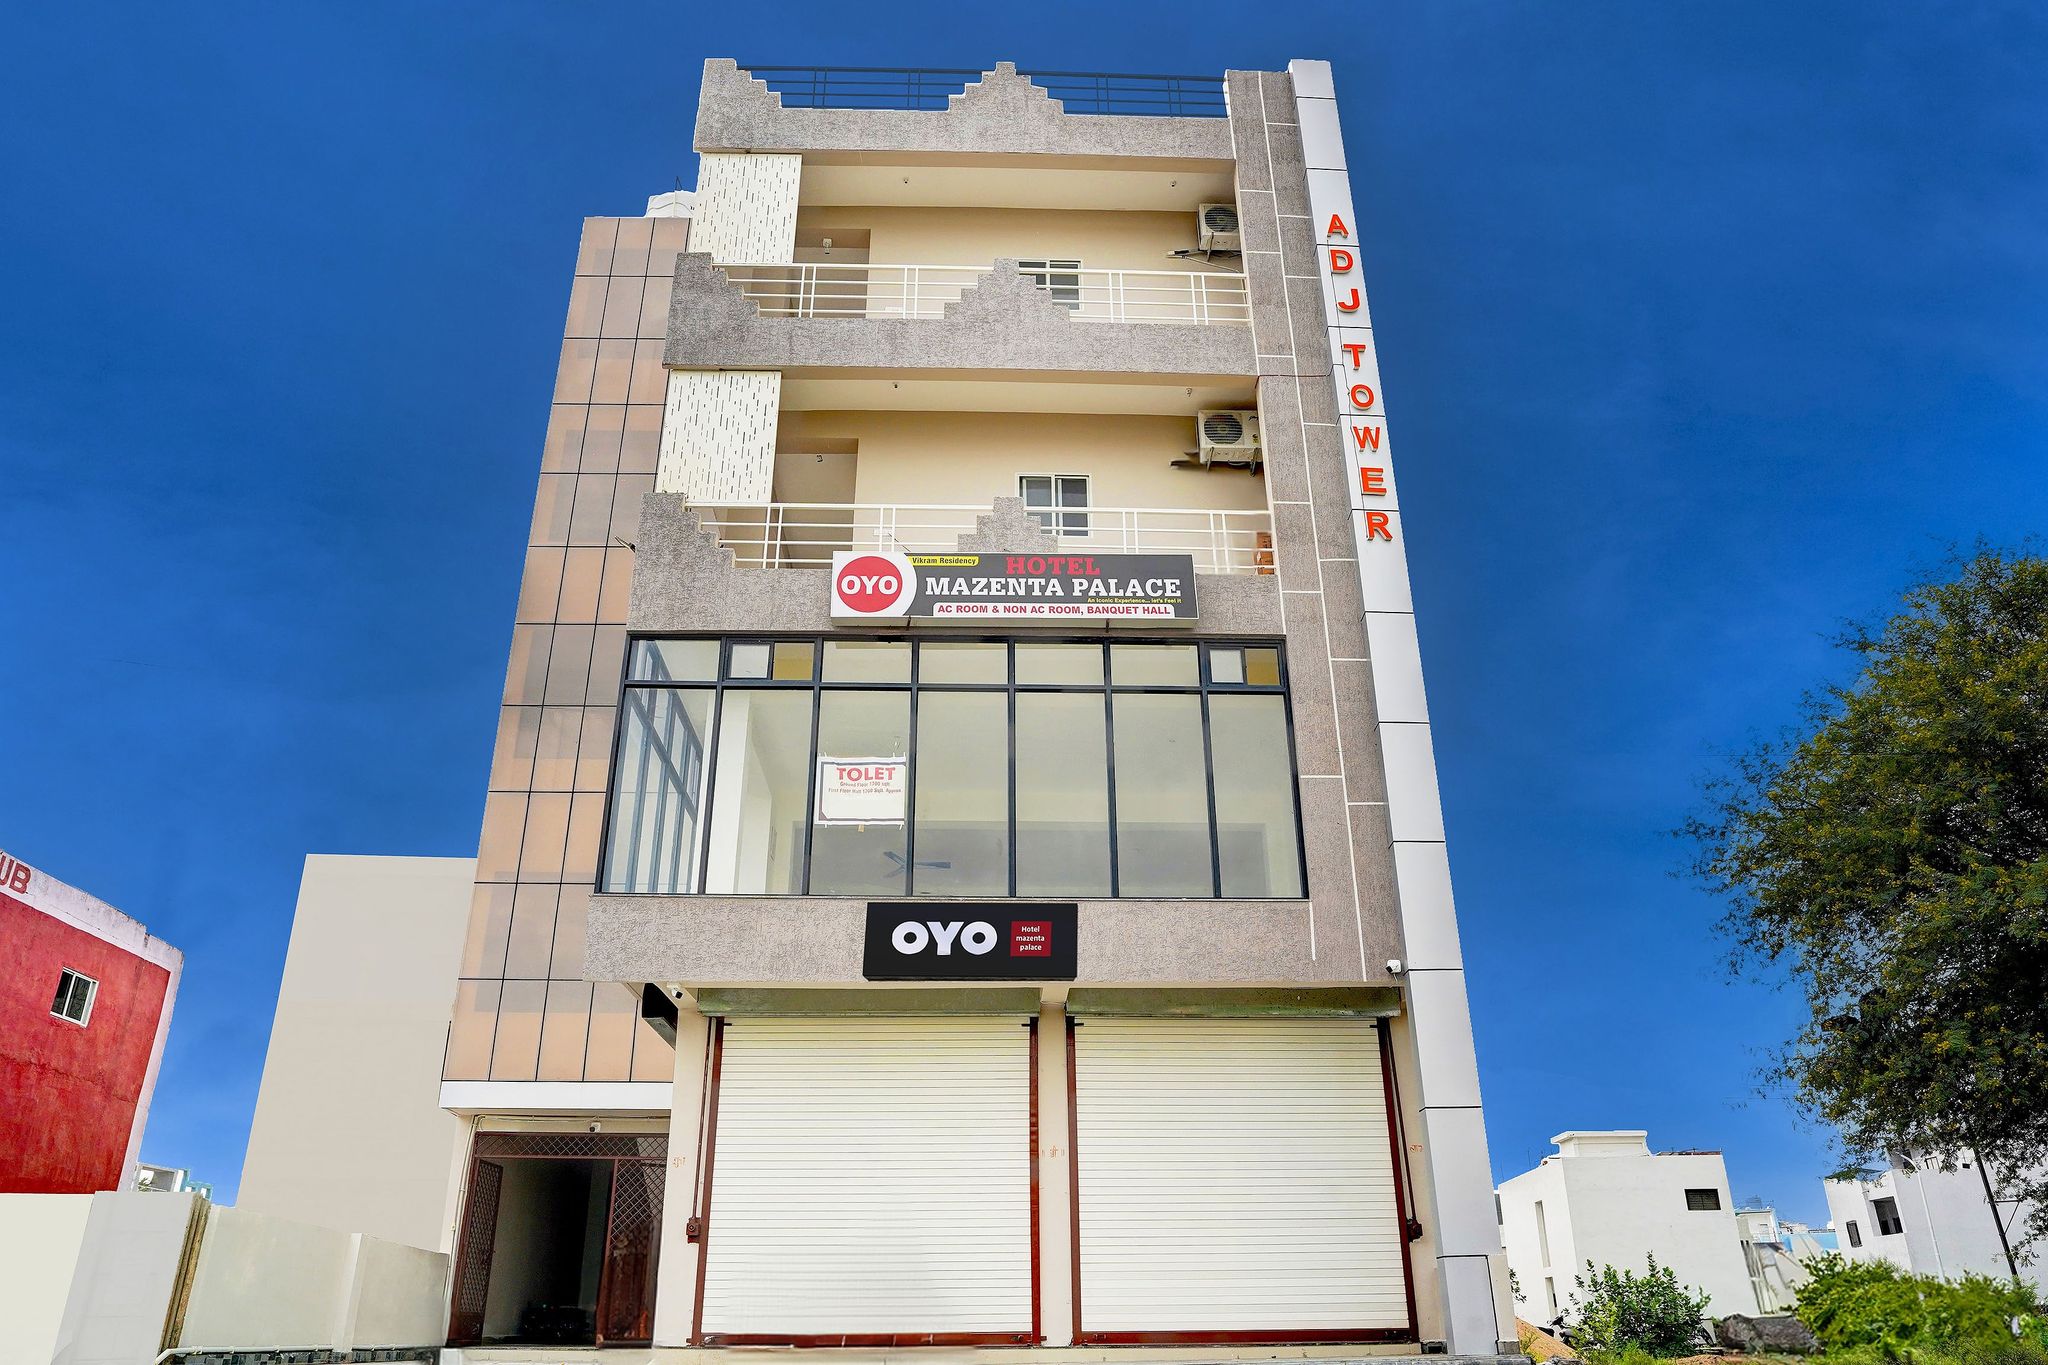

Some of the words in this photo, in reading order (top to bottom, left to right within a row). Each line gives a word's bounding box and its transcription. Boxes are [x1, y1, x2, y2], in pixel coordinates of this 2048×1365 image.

[1327, 214, 1362, 313] ADJ
[1343, 343, 1393, 542] TOWER
[912, 556, 938, 565] Vikram
[939, 556, 976, 566] Residency
[1006, 556, 1100, 575] HOTEL
[841, 575, 899, 595] OYO
[925, 577, 1065, 596] MAZENTA
[1072, 578, 1181, 597] PALACE
[938, 605, 953, 614] AC
[956, 605, 988, 614] ROOM
[991, 605, 1000, 614] &
[1003, 605, 1027, 614] NON
[1030, 605, 1045, 614] AC
[1048, 606, 1084, 616] ROOM,
[1087, 606, 1139, 615] BANQUET
[1142, 606, 1171, 615] HALL
[836, 767, 895, 781] TOLET
[0, 855, 30, 893] UB
[891, 920, 998, 956] OYO
[1021, 925, 1040, 933] Hotel
[1019, 943, 1042, 952] palace
